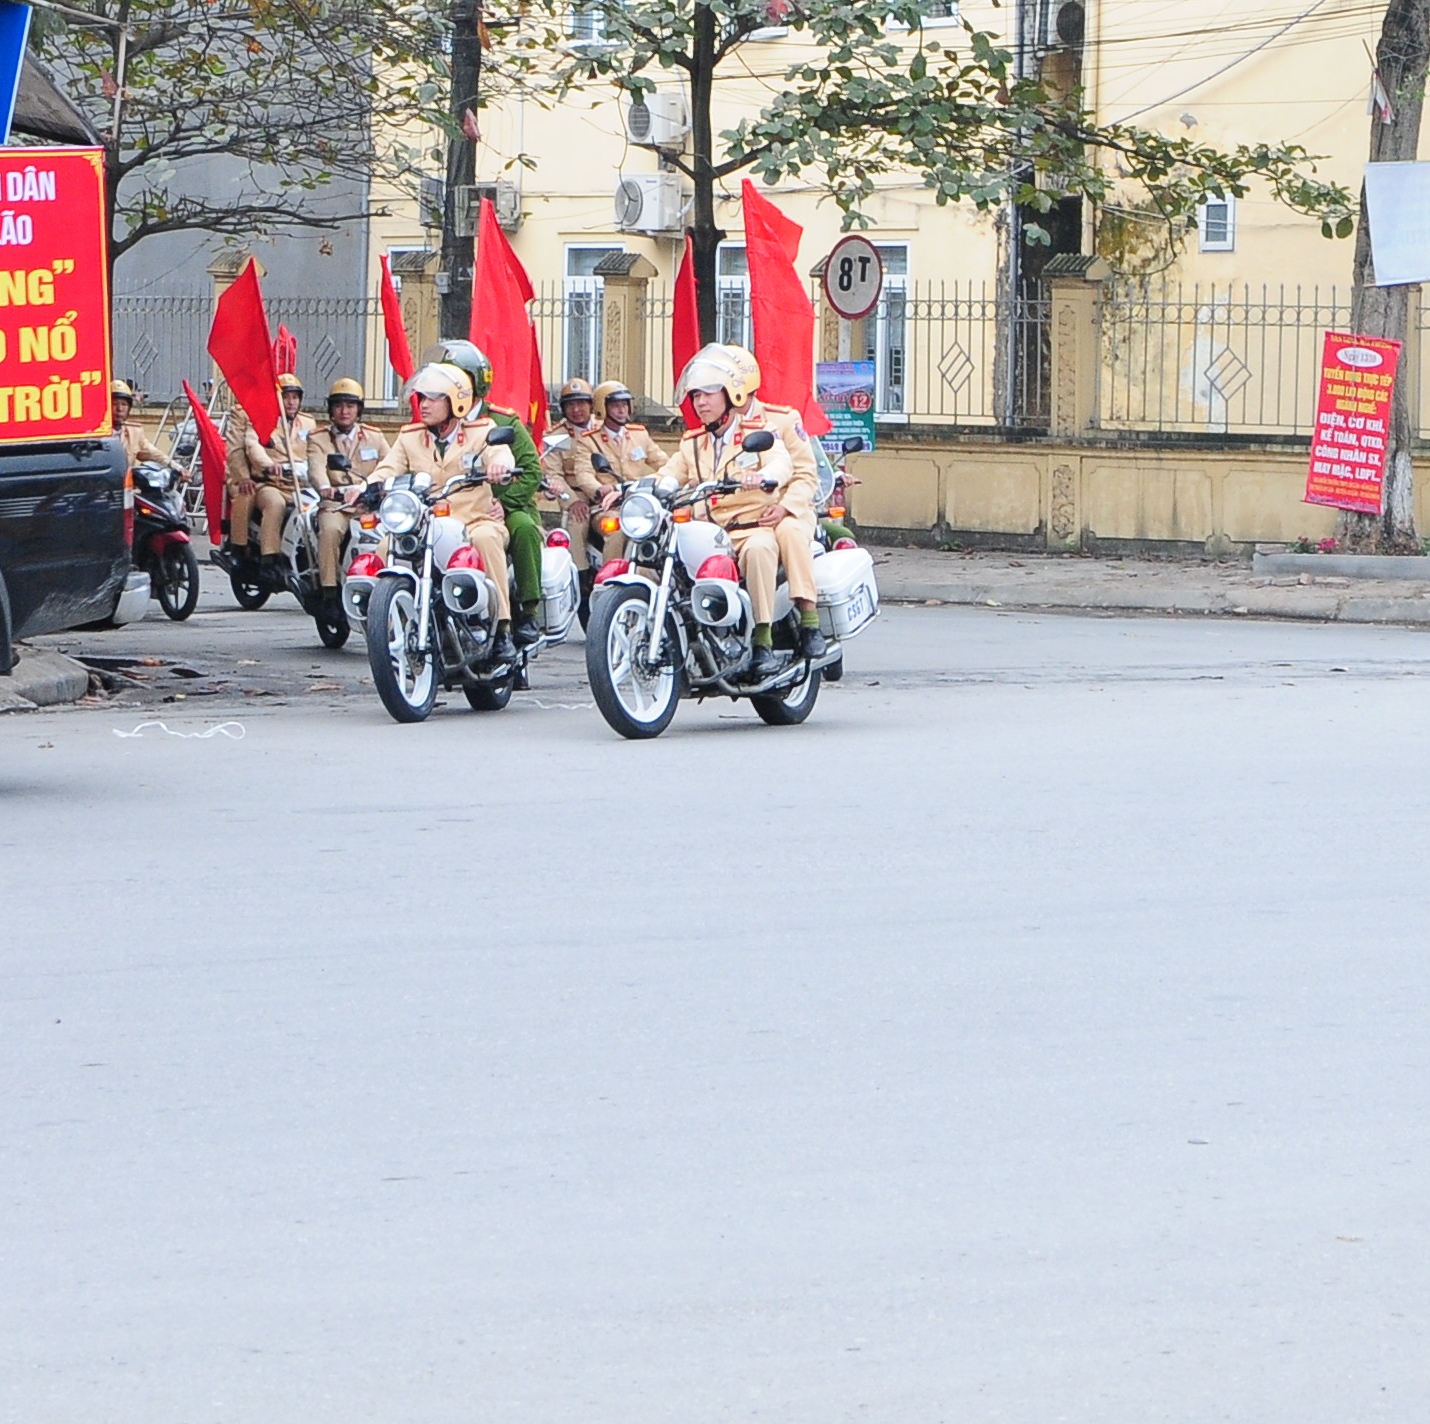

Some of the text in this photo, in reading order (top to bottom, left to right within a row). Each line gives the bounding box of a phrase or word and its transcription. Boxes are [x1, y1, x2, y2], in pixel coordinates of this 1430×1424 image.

[6, 165, 57, 202] DÂN
[838, 256, 871, 292] 8T
[19, 310, 79, 364] NỔ
[851, 394, 868, 408] 12
